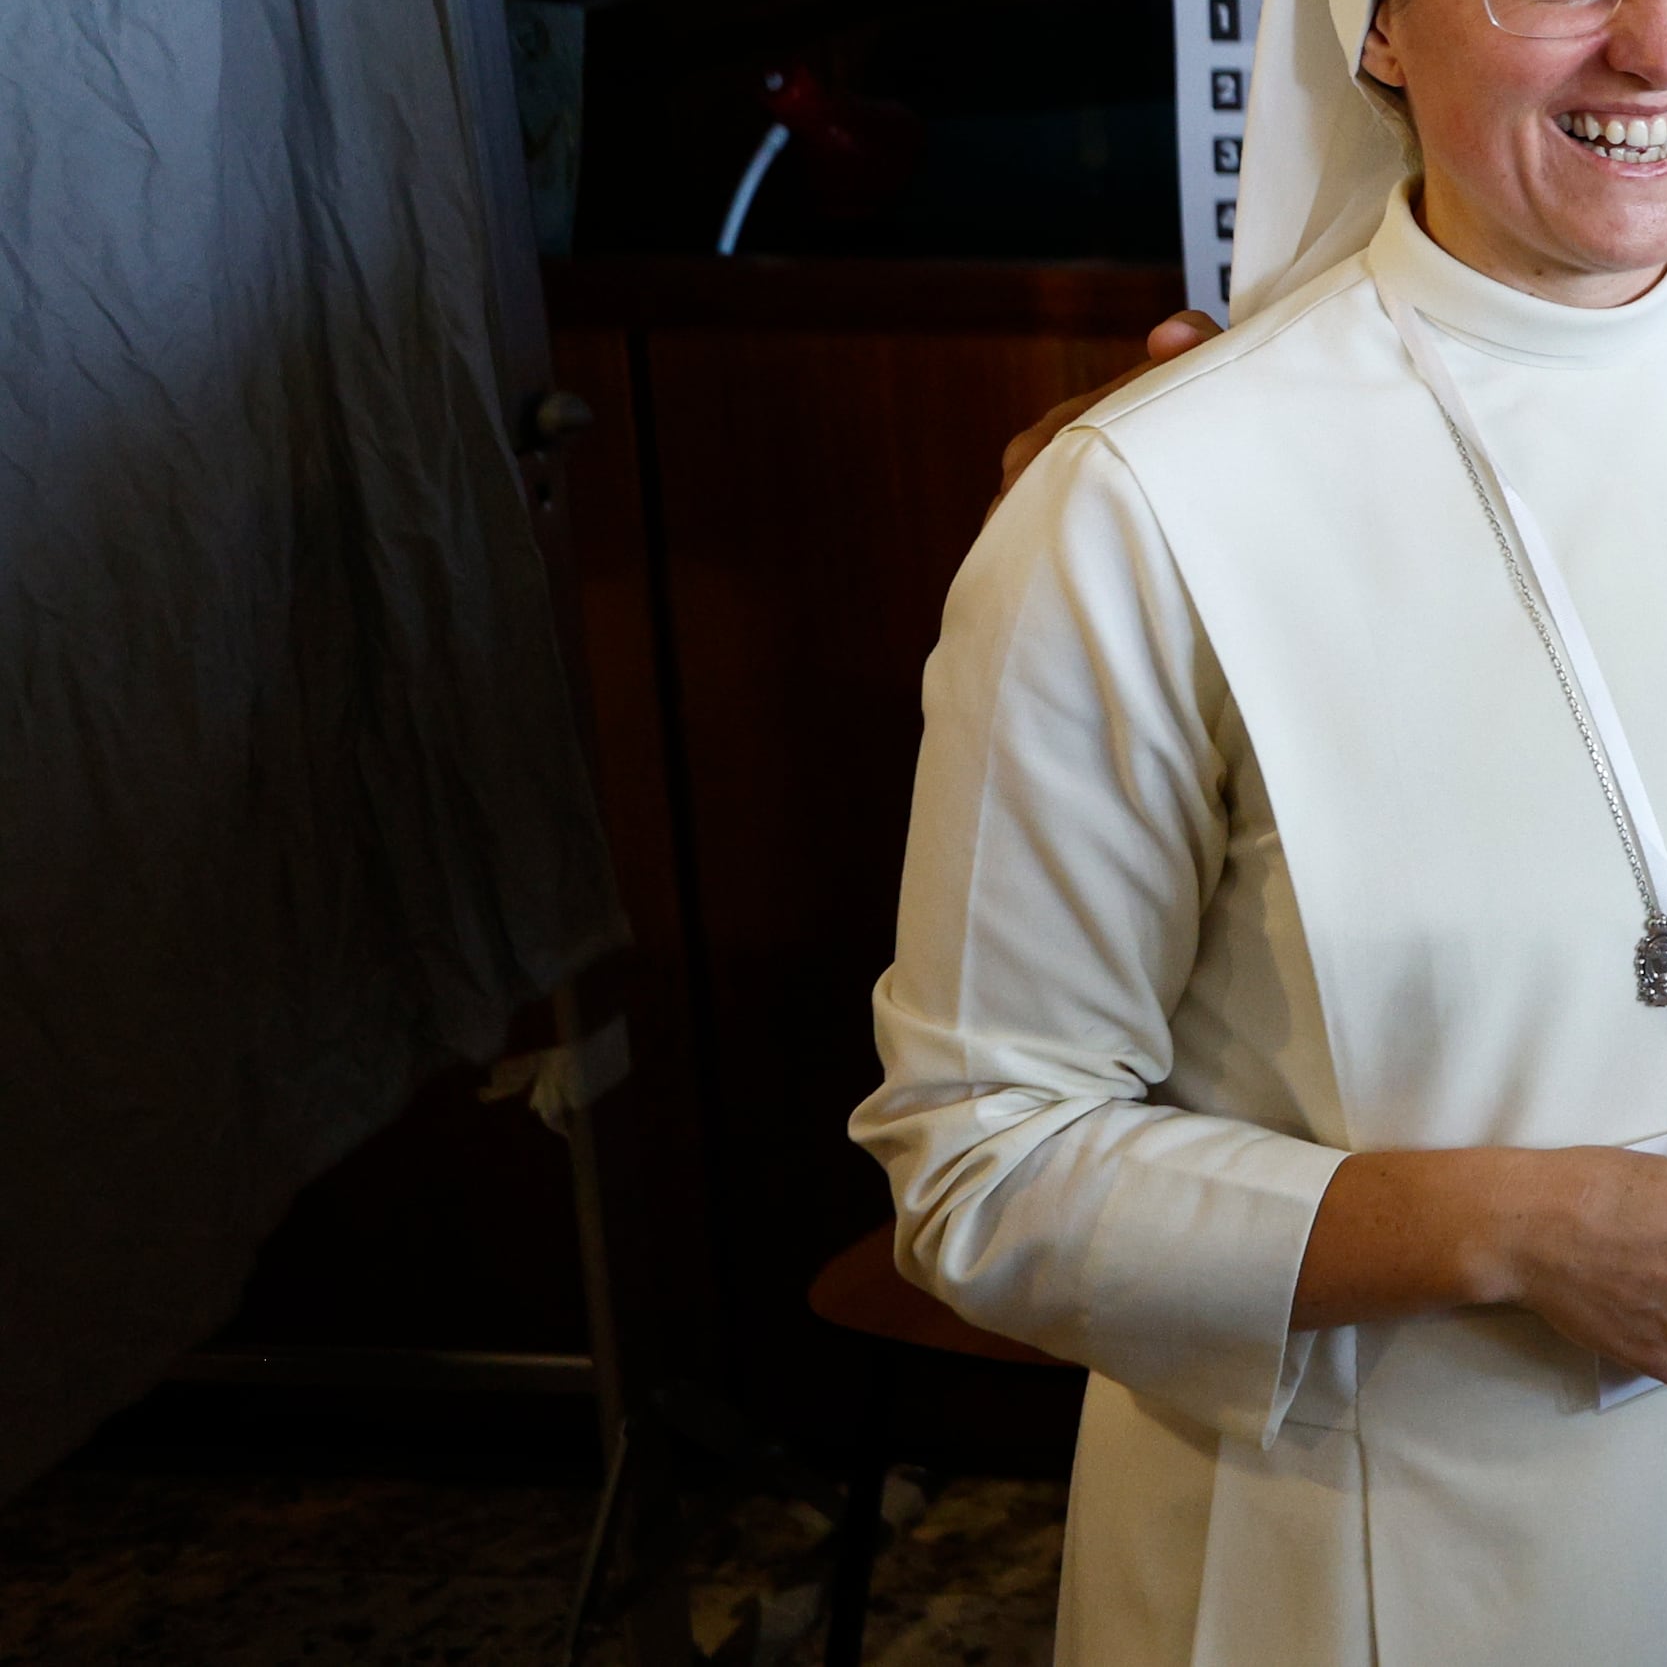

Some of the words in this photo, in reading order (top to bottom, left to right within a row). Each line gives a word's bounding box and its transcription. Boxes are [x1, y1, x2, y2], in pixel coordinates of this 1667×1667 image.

[1217, 2, 1230, 33] 1
[1216, 74, 1237, 104] 2
[1218, 139, 1240, 170] 3
